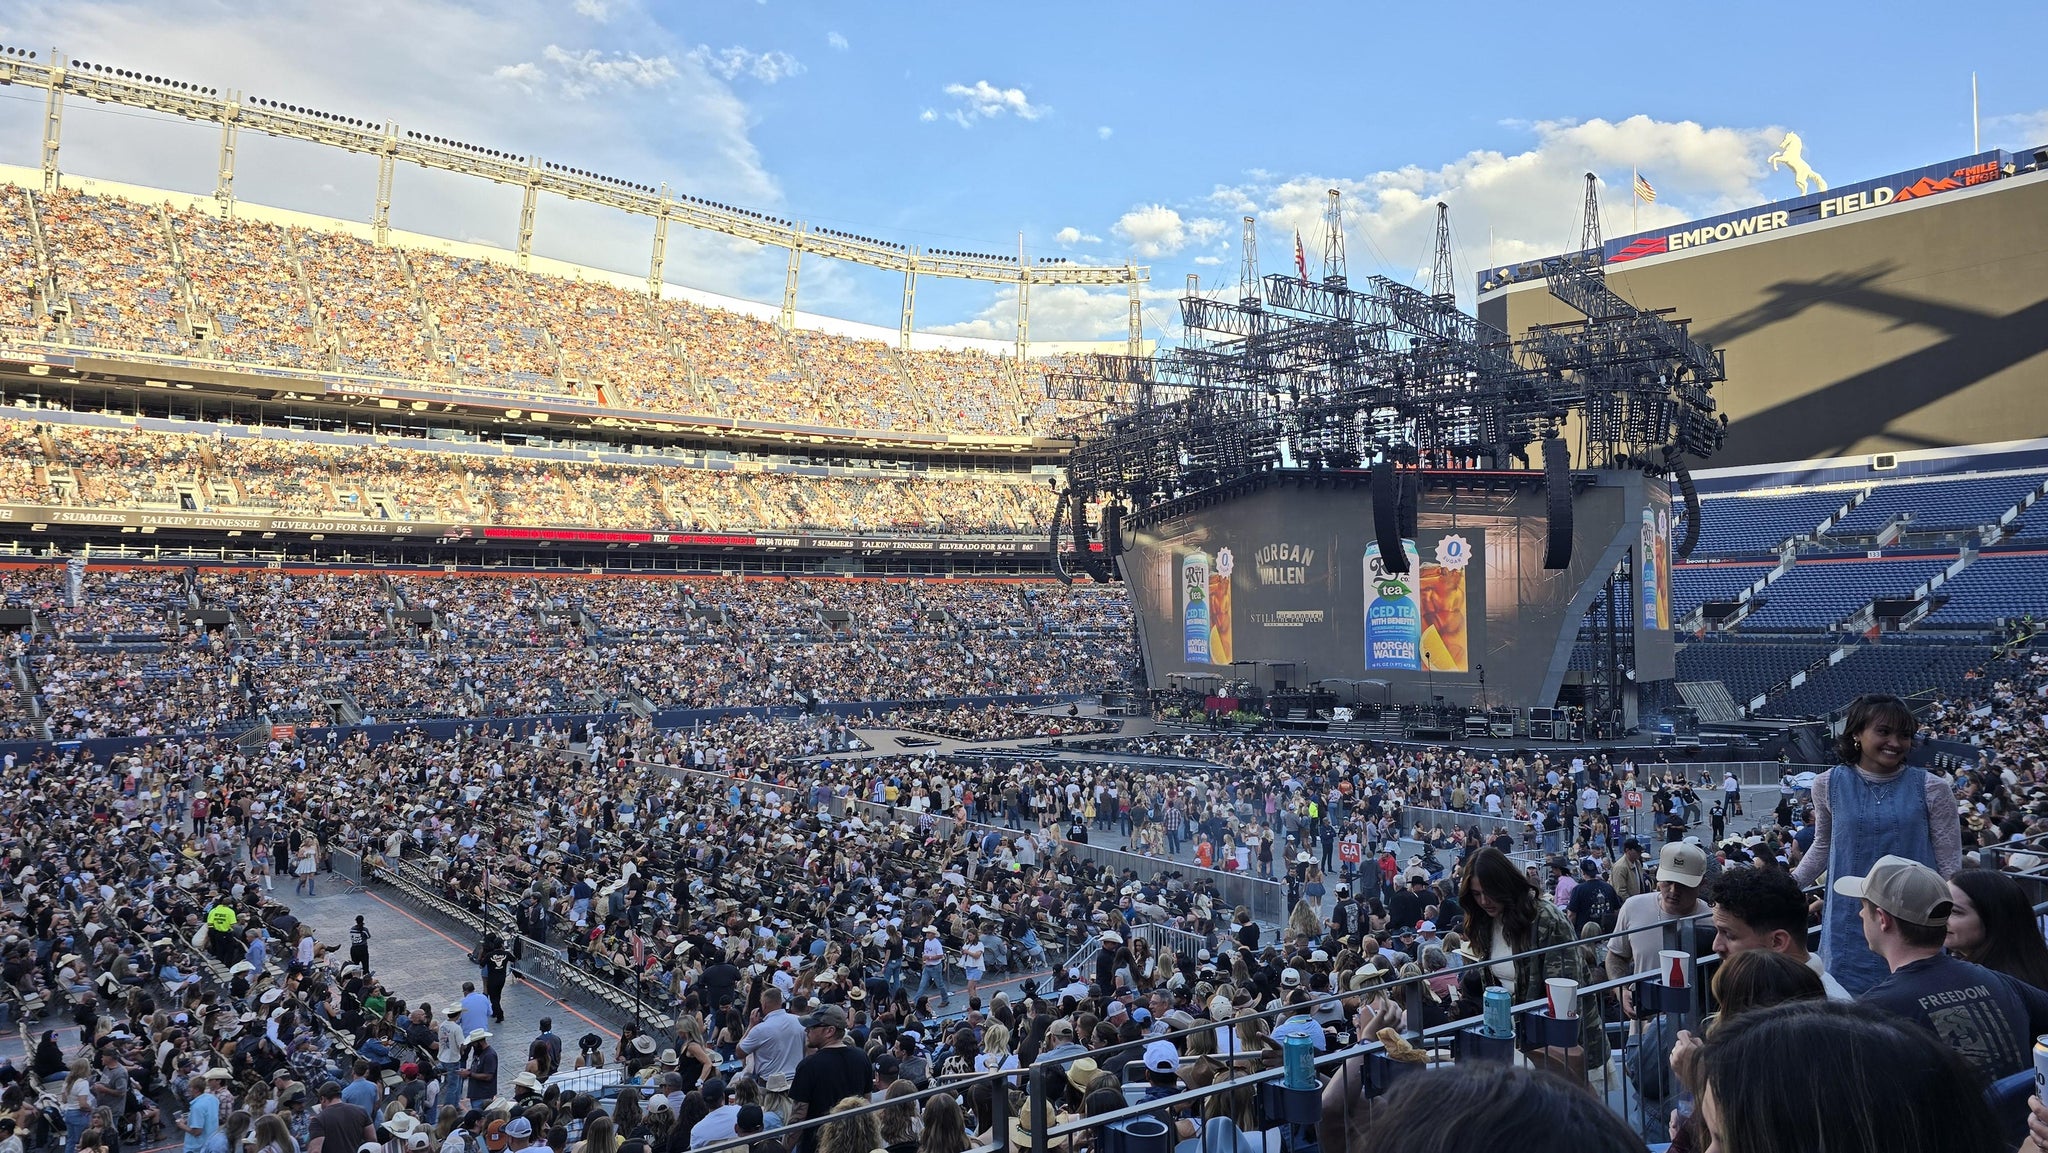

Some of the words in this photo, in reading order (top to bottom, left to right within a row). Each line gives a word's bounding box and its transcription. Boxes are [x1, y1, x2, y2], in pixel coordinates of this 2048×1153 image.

[1965, 160, 1998, 177] MILE
[1965, 169, 2000, 186] HIGH
[1668, 210, 1790, 252] EMPOWER
[1820, 186, 1895, 219] FIELD
[354, 385, 385, 395] FOLEY
[52, 512, 60, 521] 7
[61, 513, 127, 523] SUMMERS
[195, 518, 261, 529] TENNESSEE
[271, 520, 334, 531] SILVERADO
[336, 523, 358, 532] FOR
[359, 524, 387, 533] SALE
[396, 525, 413, 534] 865
[653, 534, 669, 542] TEXT
[774, 538, 783, 546] TO
[783, 538, 800, 547] VOTE!
[817, 540, 854, 548] SUMMERS
[892, 542, 933, 550] TENNESSEE
[981, 543, 996, 551] FOR
[996, 543, 1016, 551] SALE
[1254, 543, 1315, 568] MORGAN
[1185, 566, 1204, 589] Ryl
[1260, 566, 1305, 585] WALLEN
[1382, 584, 1404, 596] tea
[1369, 605, 1395, 619] ICED
[1396, 605, 1417, 619] TEA
[1250, 613, 1276, 623] STILL
[1291, 613, 1323, 623] PROBLEM
[1371, 617, 1386, 626] WITH
[1373, 641, 1415, 650] MORGAN
[1373, 650, 1415, 660] WALLEN
[1628, 792, 1641, 802] GA
[1341, 843, 1359, 857] GA
[1918, 984, 1990, 1010] FREEDOM
